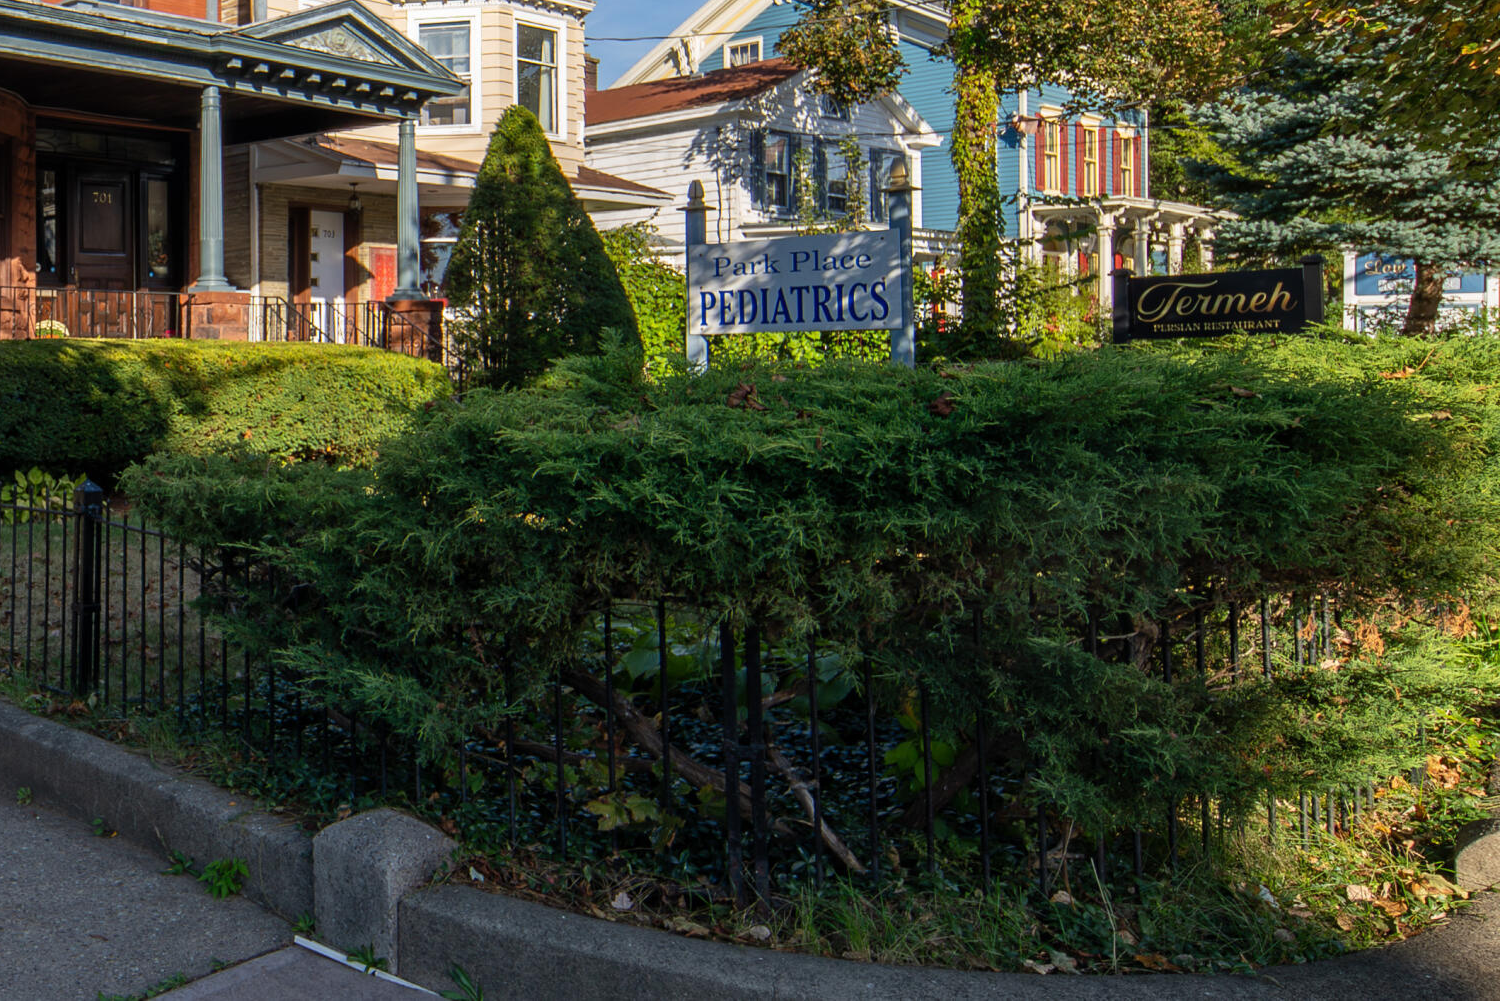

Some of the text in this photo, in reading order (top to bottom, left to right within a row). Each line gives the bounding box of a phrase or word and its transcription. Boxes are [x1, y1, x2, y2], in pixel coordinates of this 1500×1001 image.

[92, 191, 112, 205] 701
[713, 250, 872, 277] Park Place
[700, 280, 889, 326] PEDIATRICS
[1137, 280, 1298, 323] Termeh
[1153, 319, 1281, 333] PERSIAN RESTAURANT
